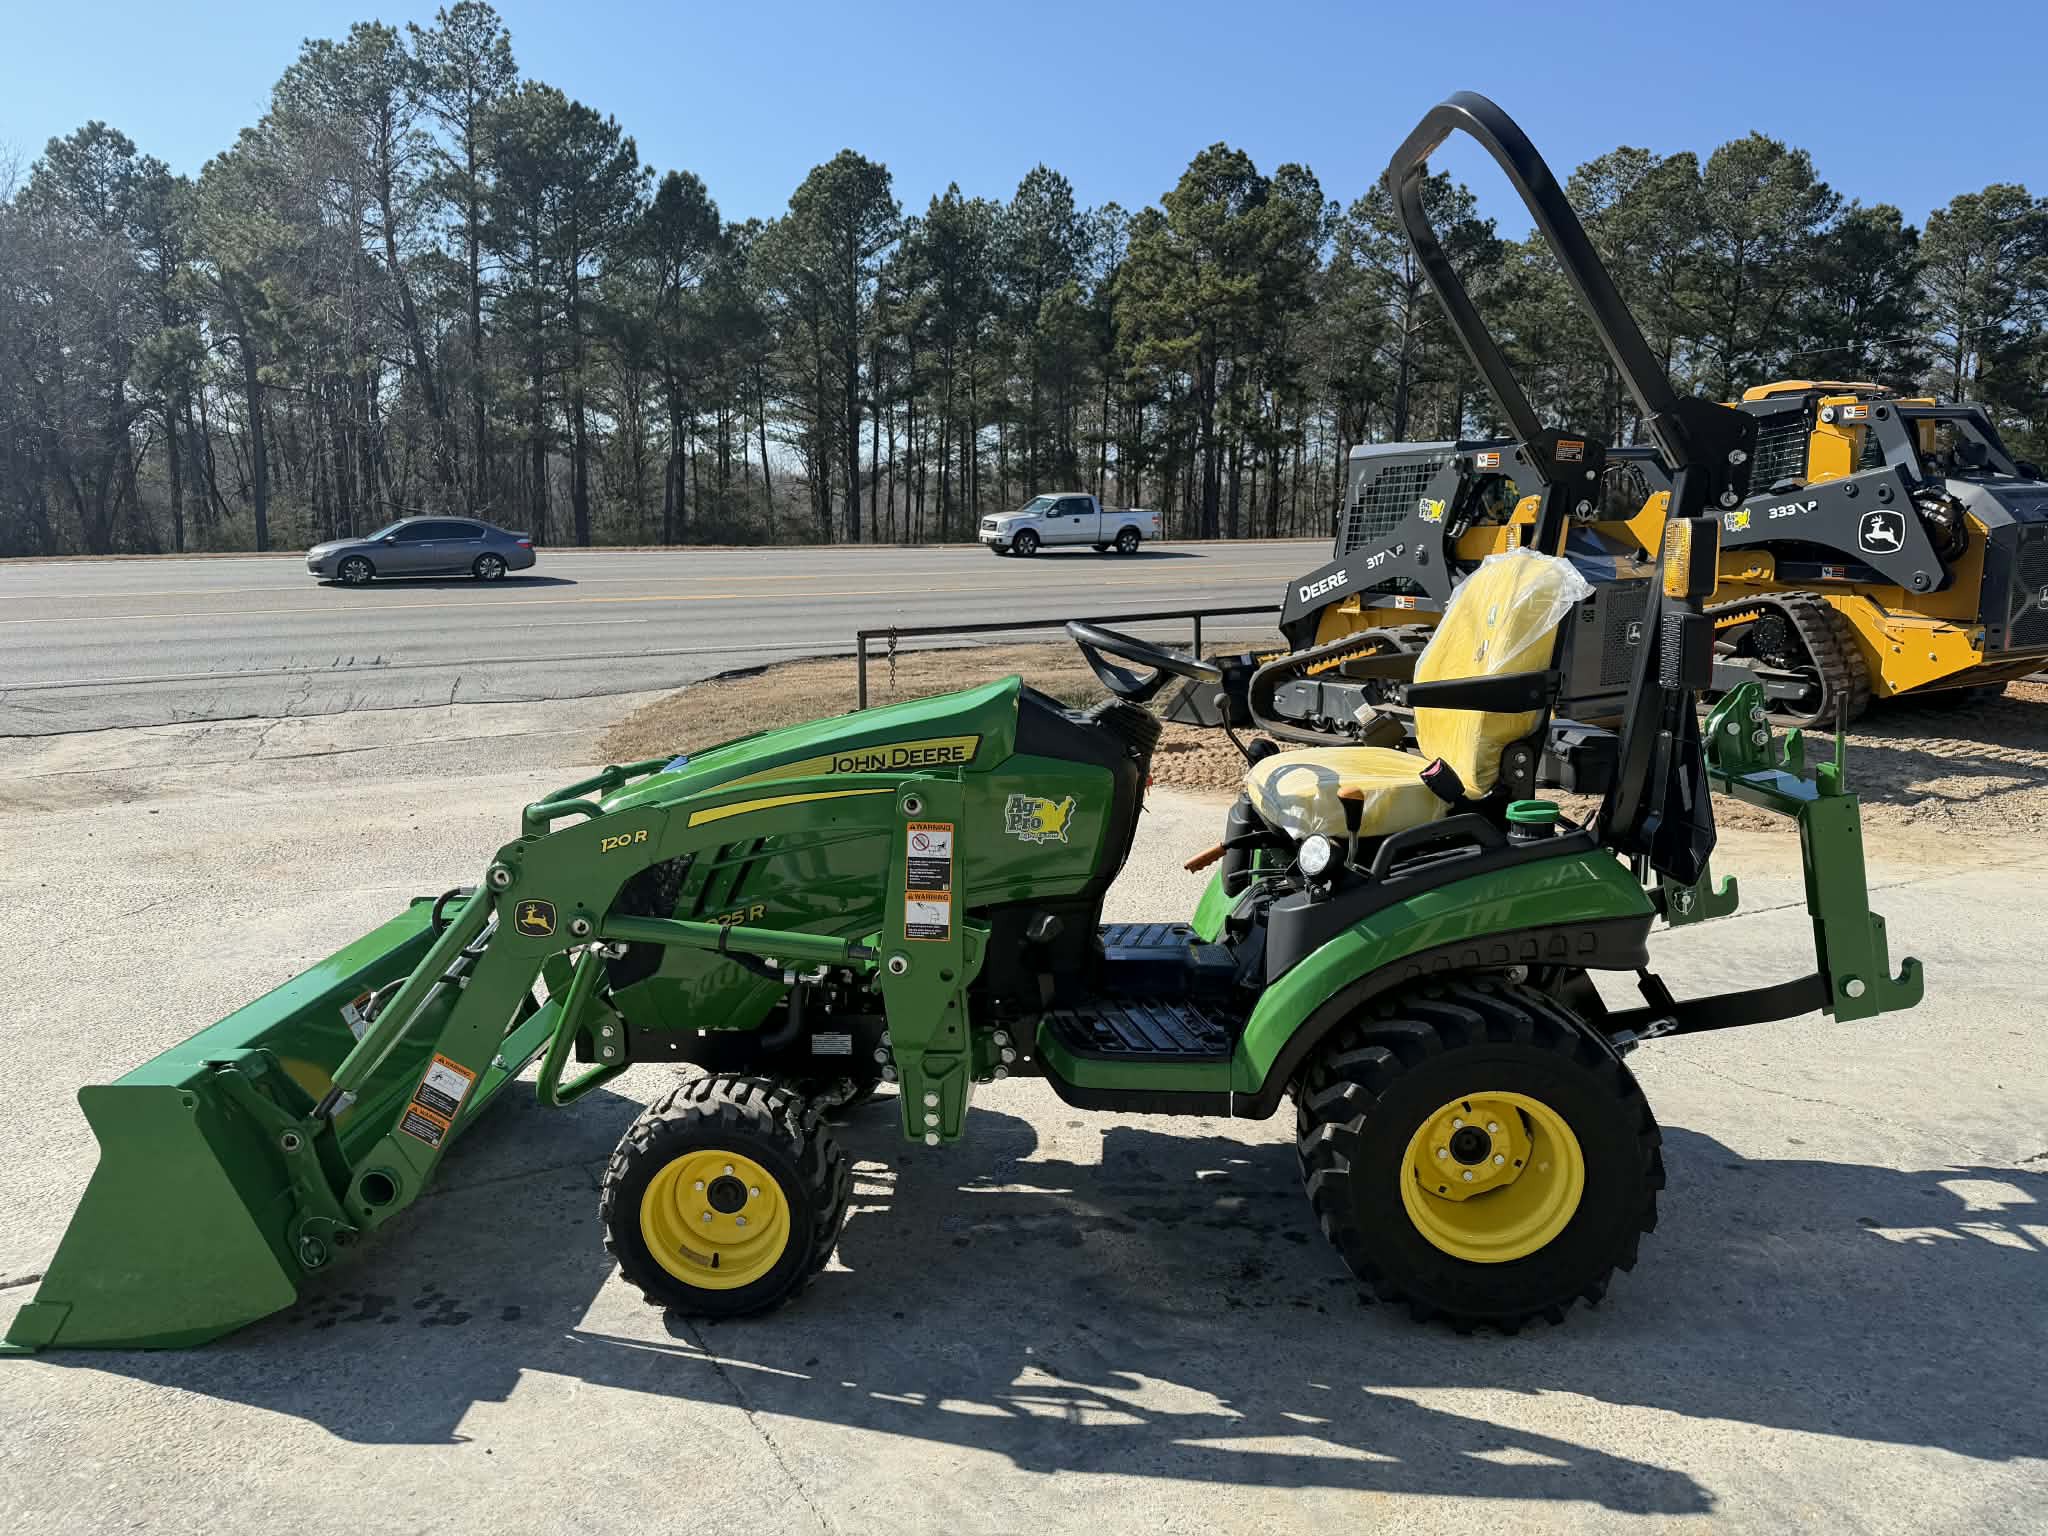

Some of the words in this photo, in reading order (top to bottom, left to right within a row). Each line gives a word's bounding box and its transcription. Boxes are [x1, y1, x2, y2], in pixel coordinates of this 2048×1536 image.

[1299, 569, 1348, 603] DEERE
[826, 754, 887, 774] JOHN
[892, 746, 965, 767] DEERE
[916, 823, 951, 831] WARNING
[1008, 812, 1043, 831] Pro
[601, 833, 632, 853] 120
[635, 830, 648, 843] R
[914, 893, 949, 901] WARNING
[750, 903, 766, 921] R
